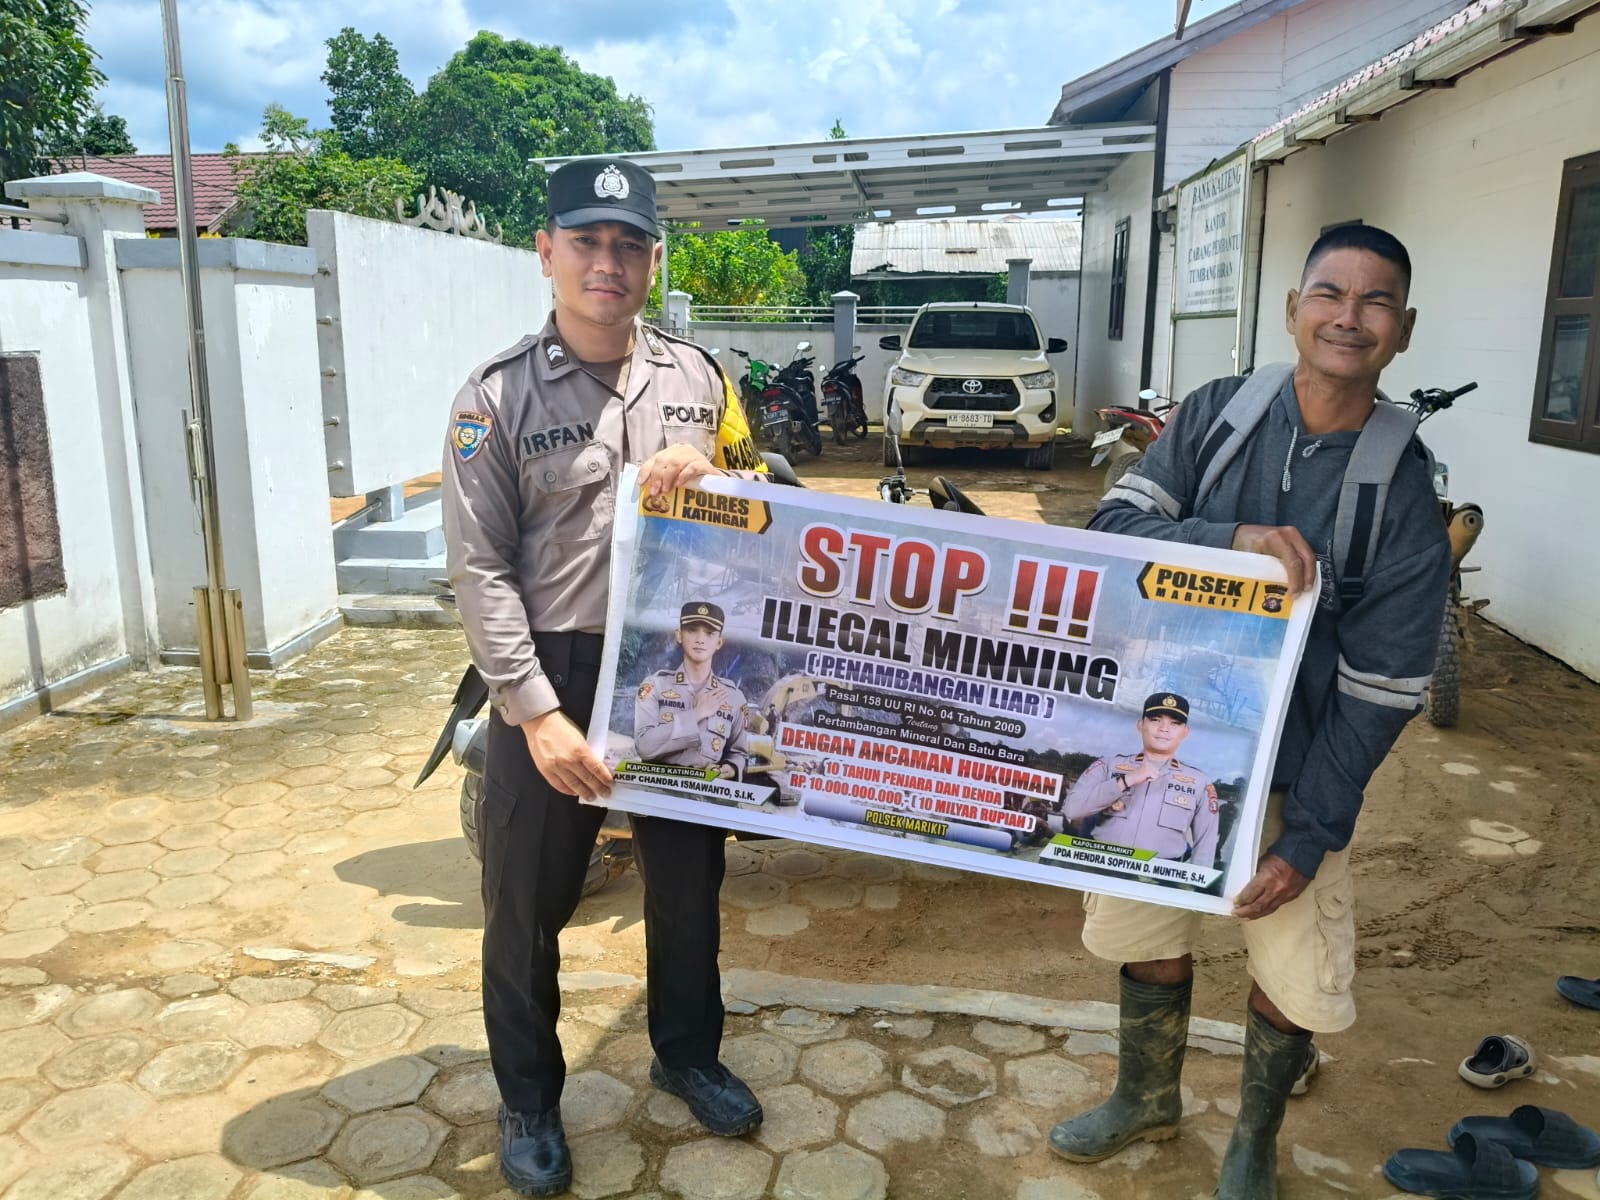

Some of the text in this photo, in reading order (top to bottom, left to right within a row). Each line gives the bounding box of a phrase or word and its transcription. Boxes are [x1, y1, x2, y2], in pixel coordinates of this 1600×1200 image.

[662, 404, 714, 426] POLRI
[522, 422, 594, 455] IRFAN
[684, 488, 750, 516] POLRES
[682, 506, 748, 528] KATINGAN
[800, 525, 988, 617] STOP
[1156, 568, 1245, 597] POLSEK
[1156, 587, 1240, 608] MARIKIT
[760, 598, 1119, 702] ILLEGAL MINNING
[716, 710, 734, 722] OLRI
[830, 689, 1022, 734] Pasal 158 UU RI No. 04 Tahun 2009
[905, 716, 938, 732] Tentang
[818, 714, 1024, 762] Pertambangan Mineral Dan Batu Bara
[626, 764, 705, 778] KAPOLRES KATINGAN
[781, 727, 1056, 796] DENGAN ANCAMAN HUKUMAN
[614, 773, 756, 800] AKBP CHANDRA ISMAWANTO, S.I.K.
[826, 762, 1002, 805] 10 TAHUN PENJARA DAN DENDA
[1168, 783, 1196, 795] POLRI
[790, 774, 806, 788] RP.
[920, 796, 932, 811] 10
[936, 800, 978, 819] MILYAR
[980, 807, 1026, 829] RUPIAH
[866, 810, 948, 836] POLSEK MARIKIT
[1107, 845, 1134, 856] MARIKIT
[1053, 847, 1206, 884] IPDA HENDRA SOPIYAN D. MUNTHE, S.H.
